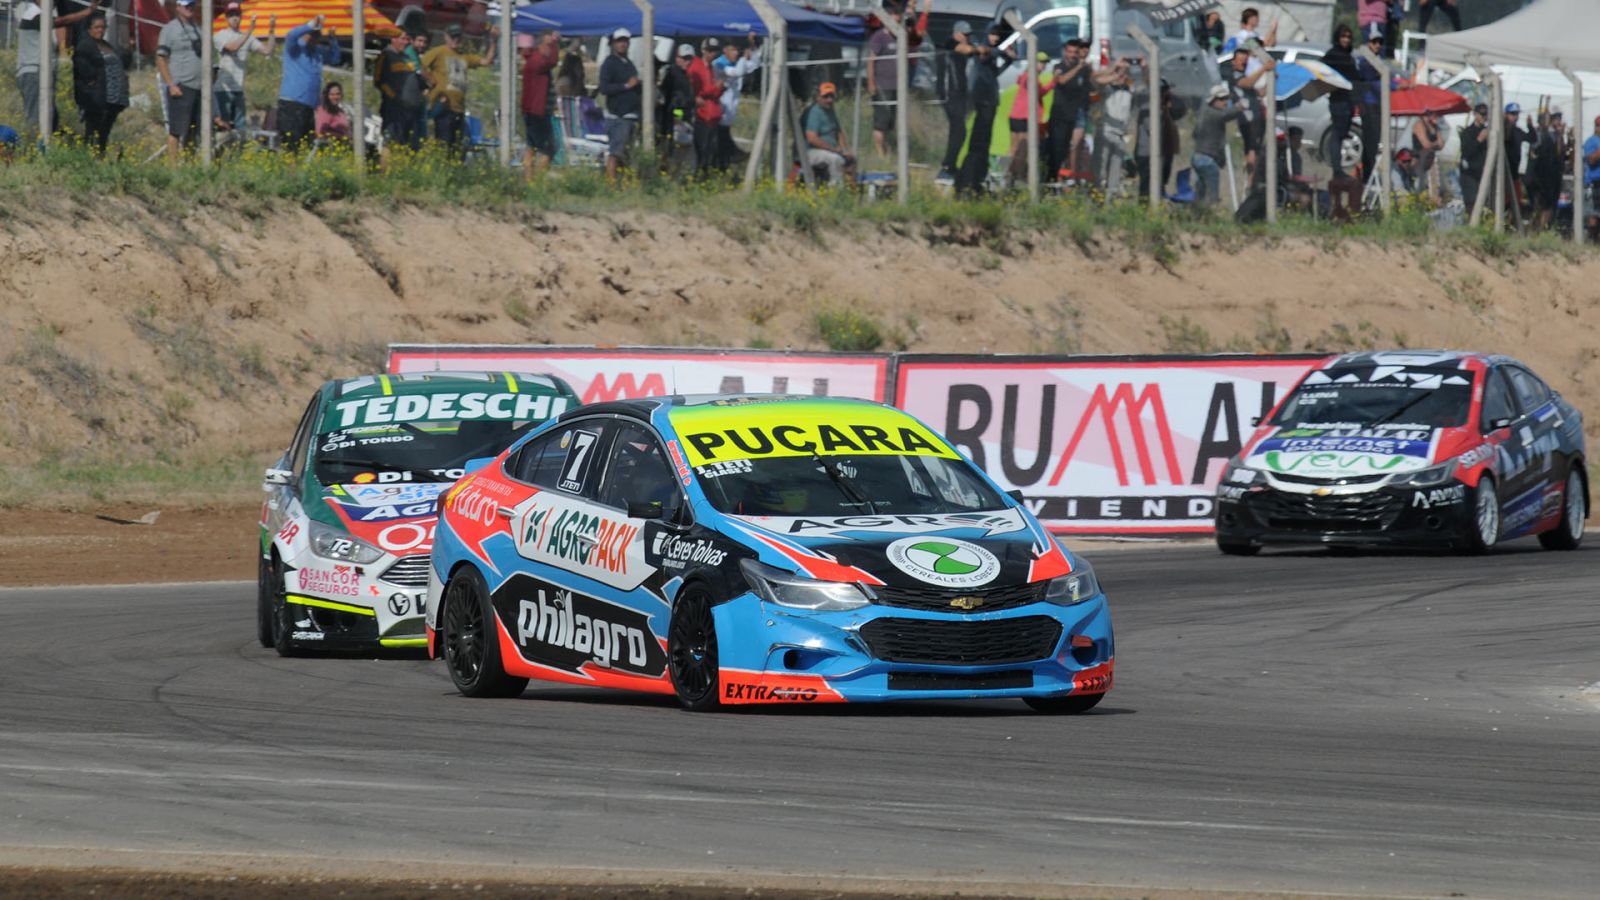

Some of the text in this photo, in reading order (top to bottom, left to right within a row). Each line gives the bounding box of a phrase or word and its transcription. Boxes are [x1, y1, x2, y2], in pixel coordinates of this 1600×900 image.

[336, 392, 568, 428] TEDESCHI
[359, 435, 414, 446] TONDO
[685, 424, 944, 460] PUCARA
[945, 382, 1276, 487] RUMA
[1280, 438, 1410, 450] Internet
[574, 433, 595, 481] 7
[710, 459, 753, 471] TETI
[378, 470, 413, 483] DI
[704, 467, 743, 478] CLASE
[358, 484, 437, 498] Agro
[547, 509, 638, 576] AGROPACK
[668, 534, 696, 560] Ceres
[691, 539, 728, 566] Tolvas
[309, 568, 360, 586] SANCOR
[906, 563, 967, 583] CEREALES
[308, 581, 360, 597] SEGUROS
[517, 589, 647, 668] philagro
